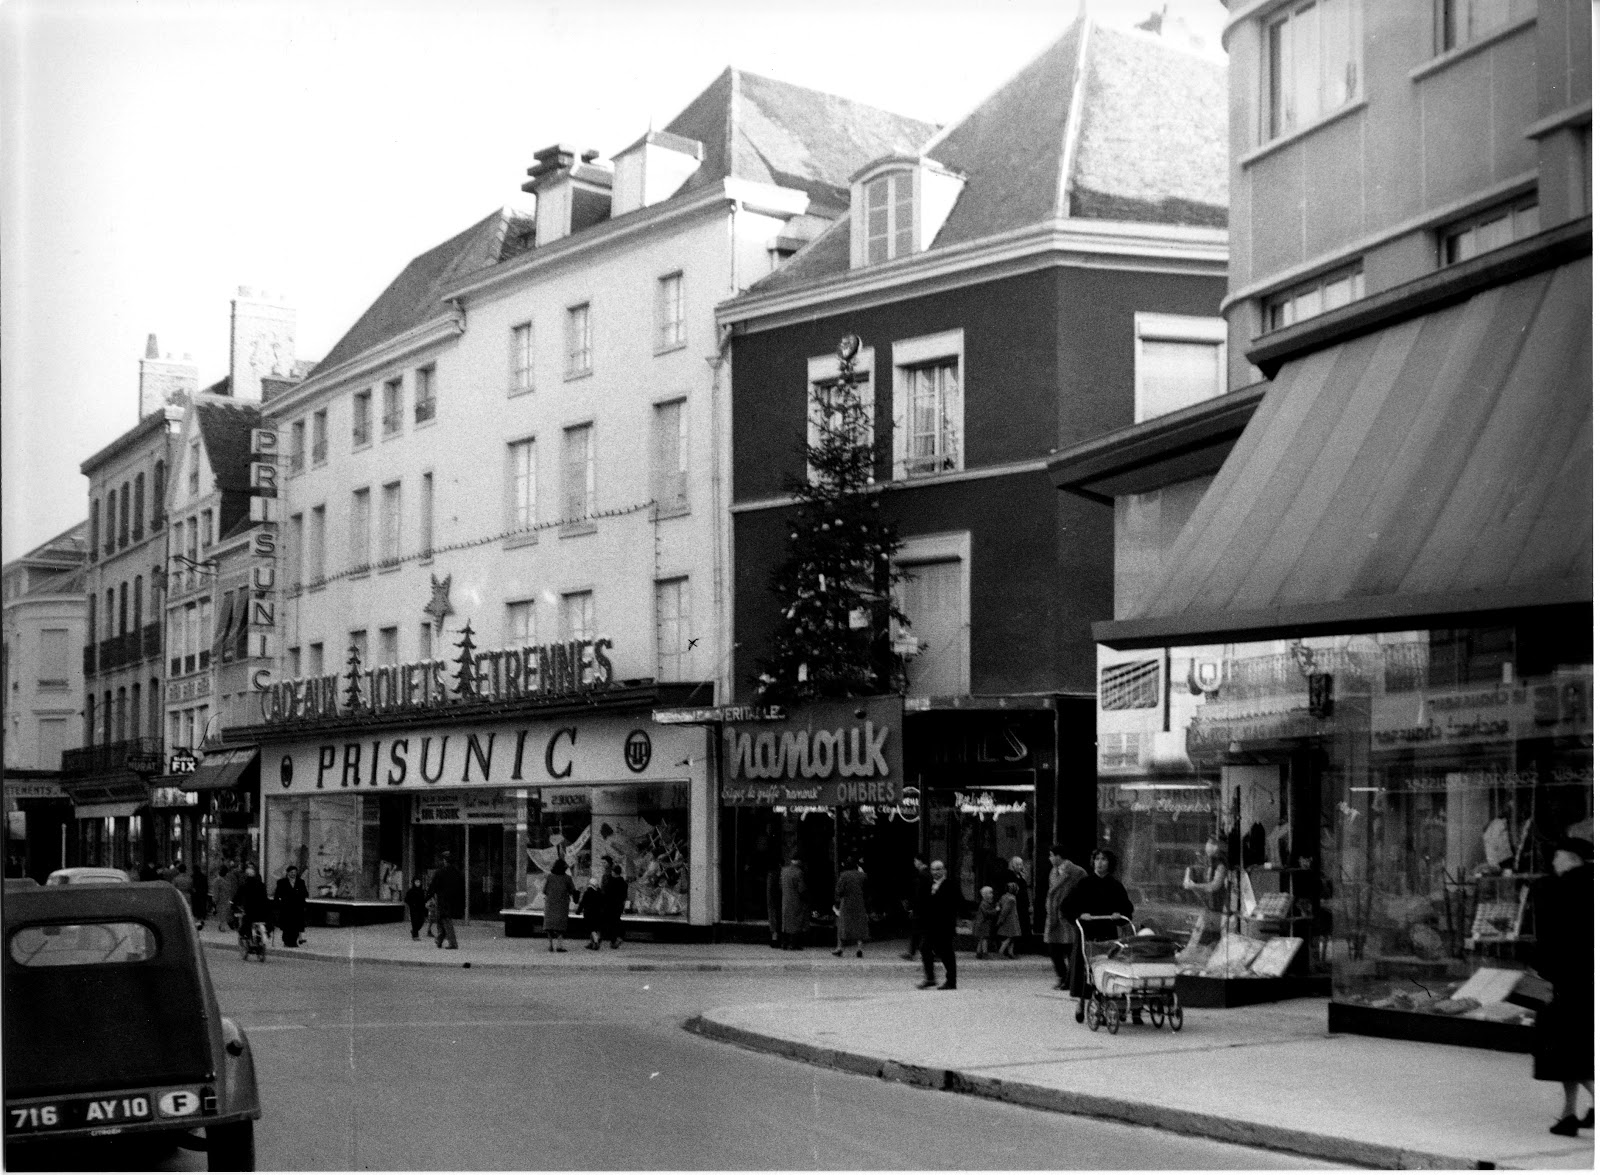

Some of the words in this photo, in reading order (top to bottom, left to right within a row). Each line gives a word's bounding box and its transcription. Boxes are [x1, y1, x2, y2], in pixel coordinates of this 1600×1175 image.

[252, 428, 278, 692] PRISUNIC
[260, 673, 340, 722] CADEAUX
[364, 660, 447, 712] JOUETS
[474, 637, 613, 700] ETRENNES
[171, 761, 196, 773] FIX
[316, 726, 578, 788] PRISUNIC
[756, 785, 780, 804] griffe
[836, 782, 896, 803] OMBRES
[11, 1106, 58, 1128] 716
[86, 1100, 118, 1120] AY
[122, 1097, 149, 1118] 10
[172, 1094, 189, 1113] F
